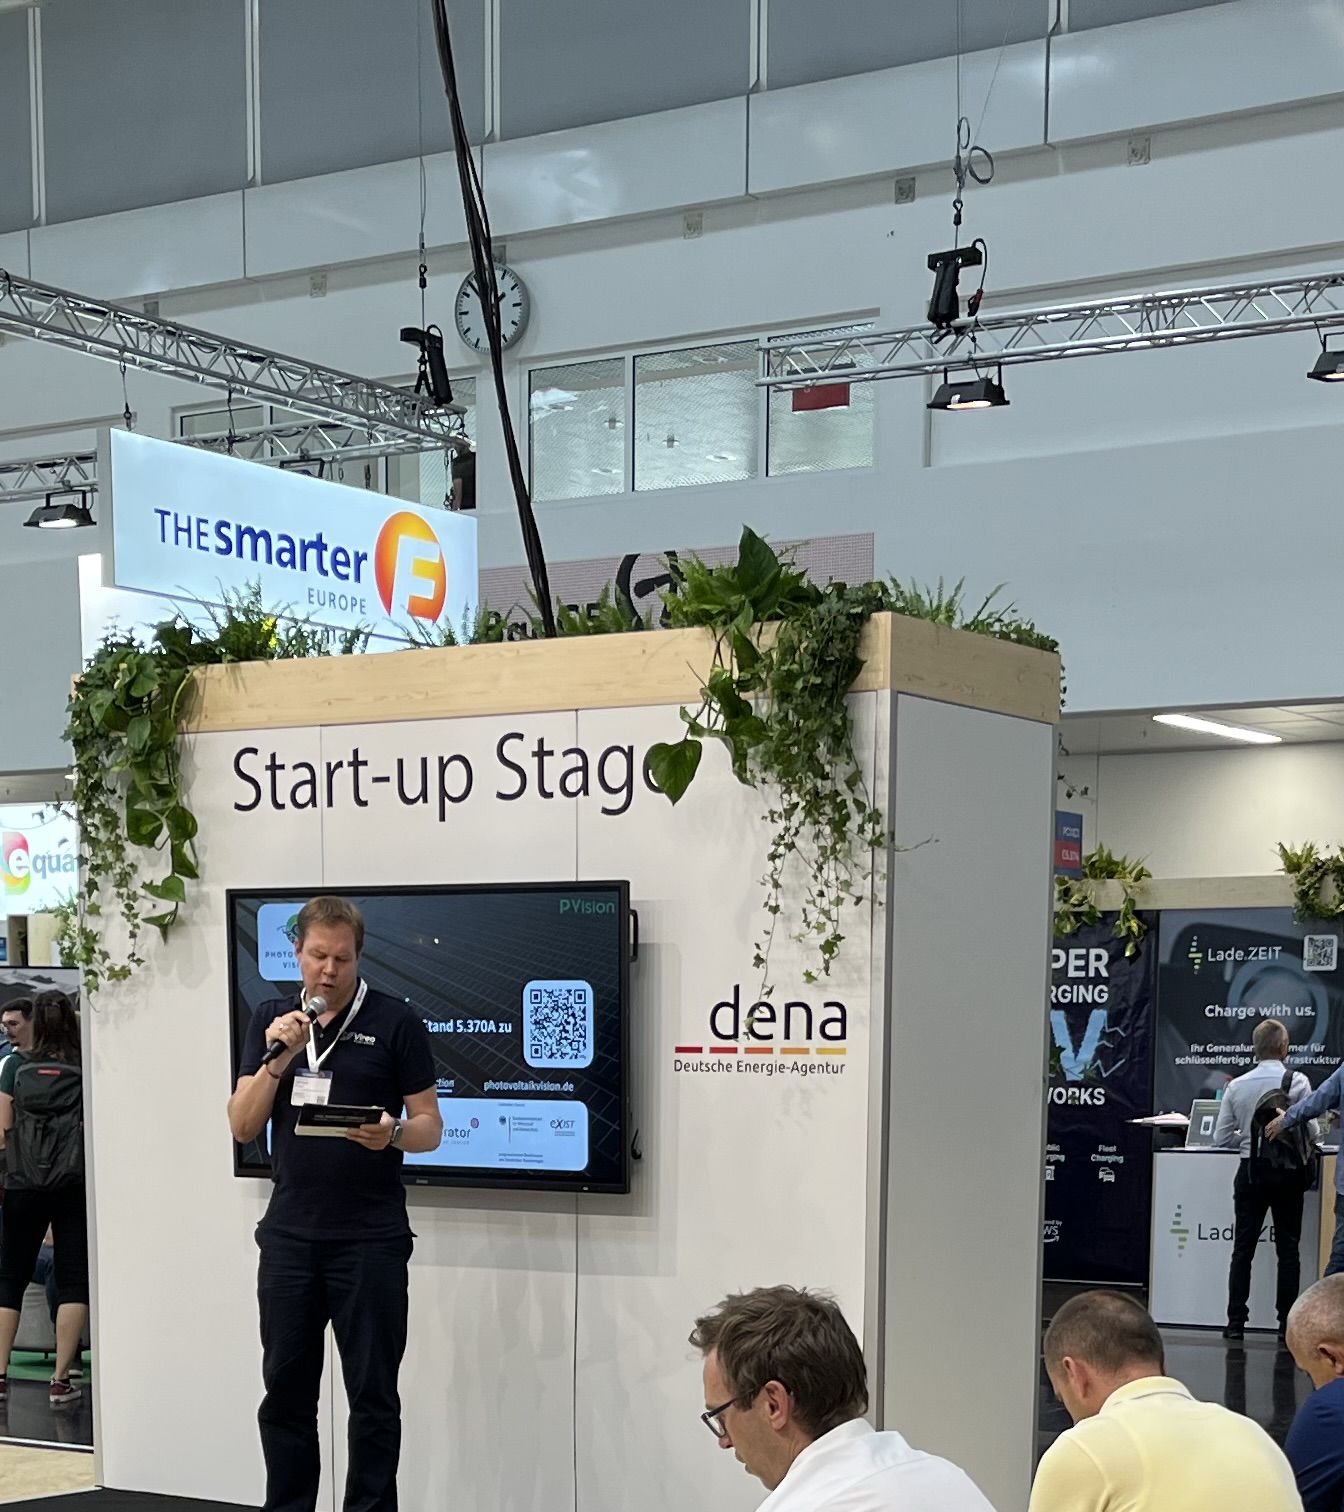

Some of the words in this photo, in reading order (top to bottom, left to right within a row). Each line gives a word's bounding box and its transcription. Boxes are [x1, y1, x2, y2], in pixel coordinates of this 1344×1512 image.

[214, 518, 368, 585] smarter
[307, 587, 367, 616] EUROPE
[233, 746, 474, 823] Start-up
[559, 898, 616, 915] PVision
[1207, 946, 1282, 962] Lade.ZEIT
[709, 983, 847, 1042] dena
[1204, 1004, 1256, 1019] Charge
[1258, 1003, 1291, 1016] with
[1294, 1005, 1316, 1016] us.
[456, 1018, 496, 1034] 5.370A
[498, 1022, 512, 1034] zu
[1190, 1043, 1205, 1053] Ihr
[1310, 1043, 1326, 1053] für
[673, 1059, 733, 1073] Deutsche
[736, 1060, 846, 1077] Energie-Agentur
[1174, 1055, 1251, 1067] schlüsselfertige
[483, 1080, 574, 1092] photovoltaikvision.de
[1090, 1154, 1124, 1164] Charging
